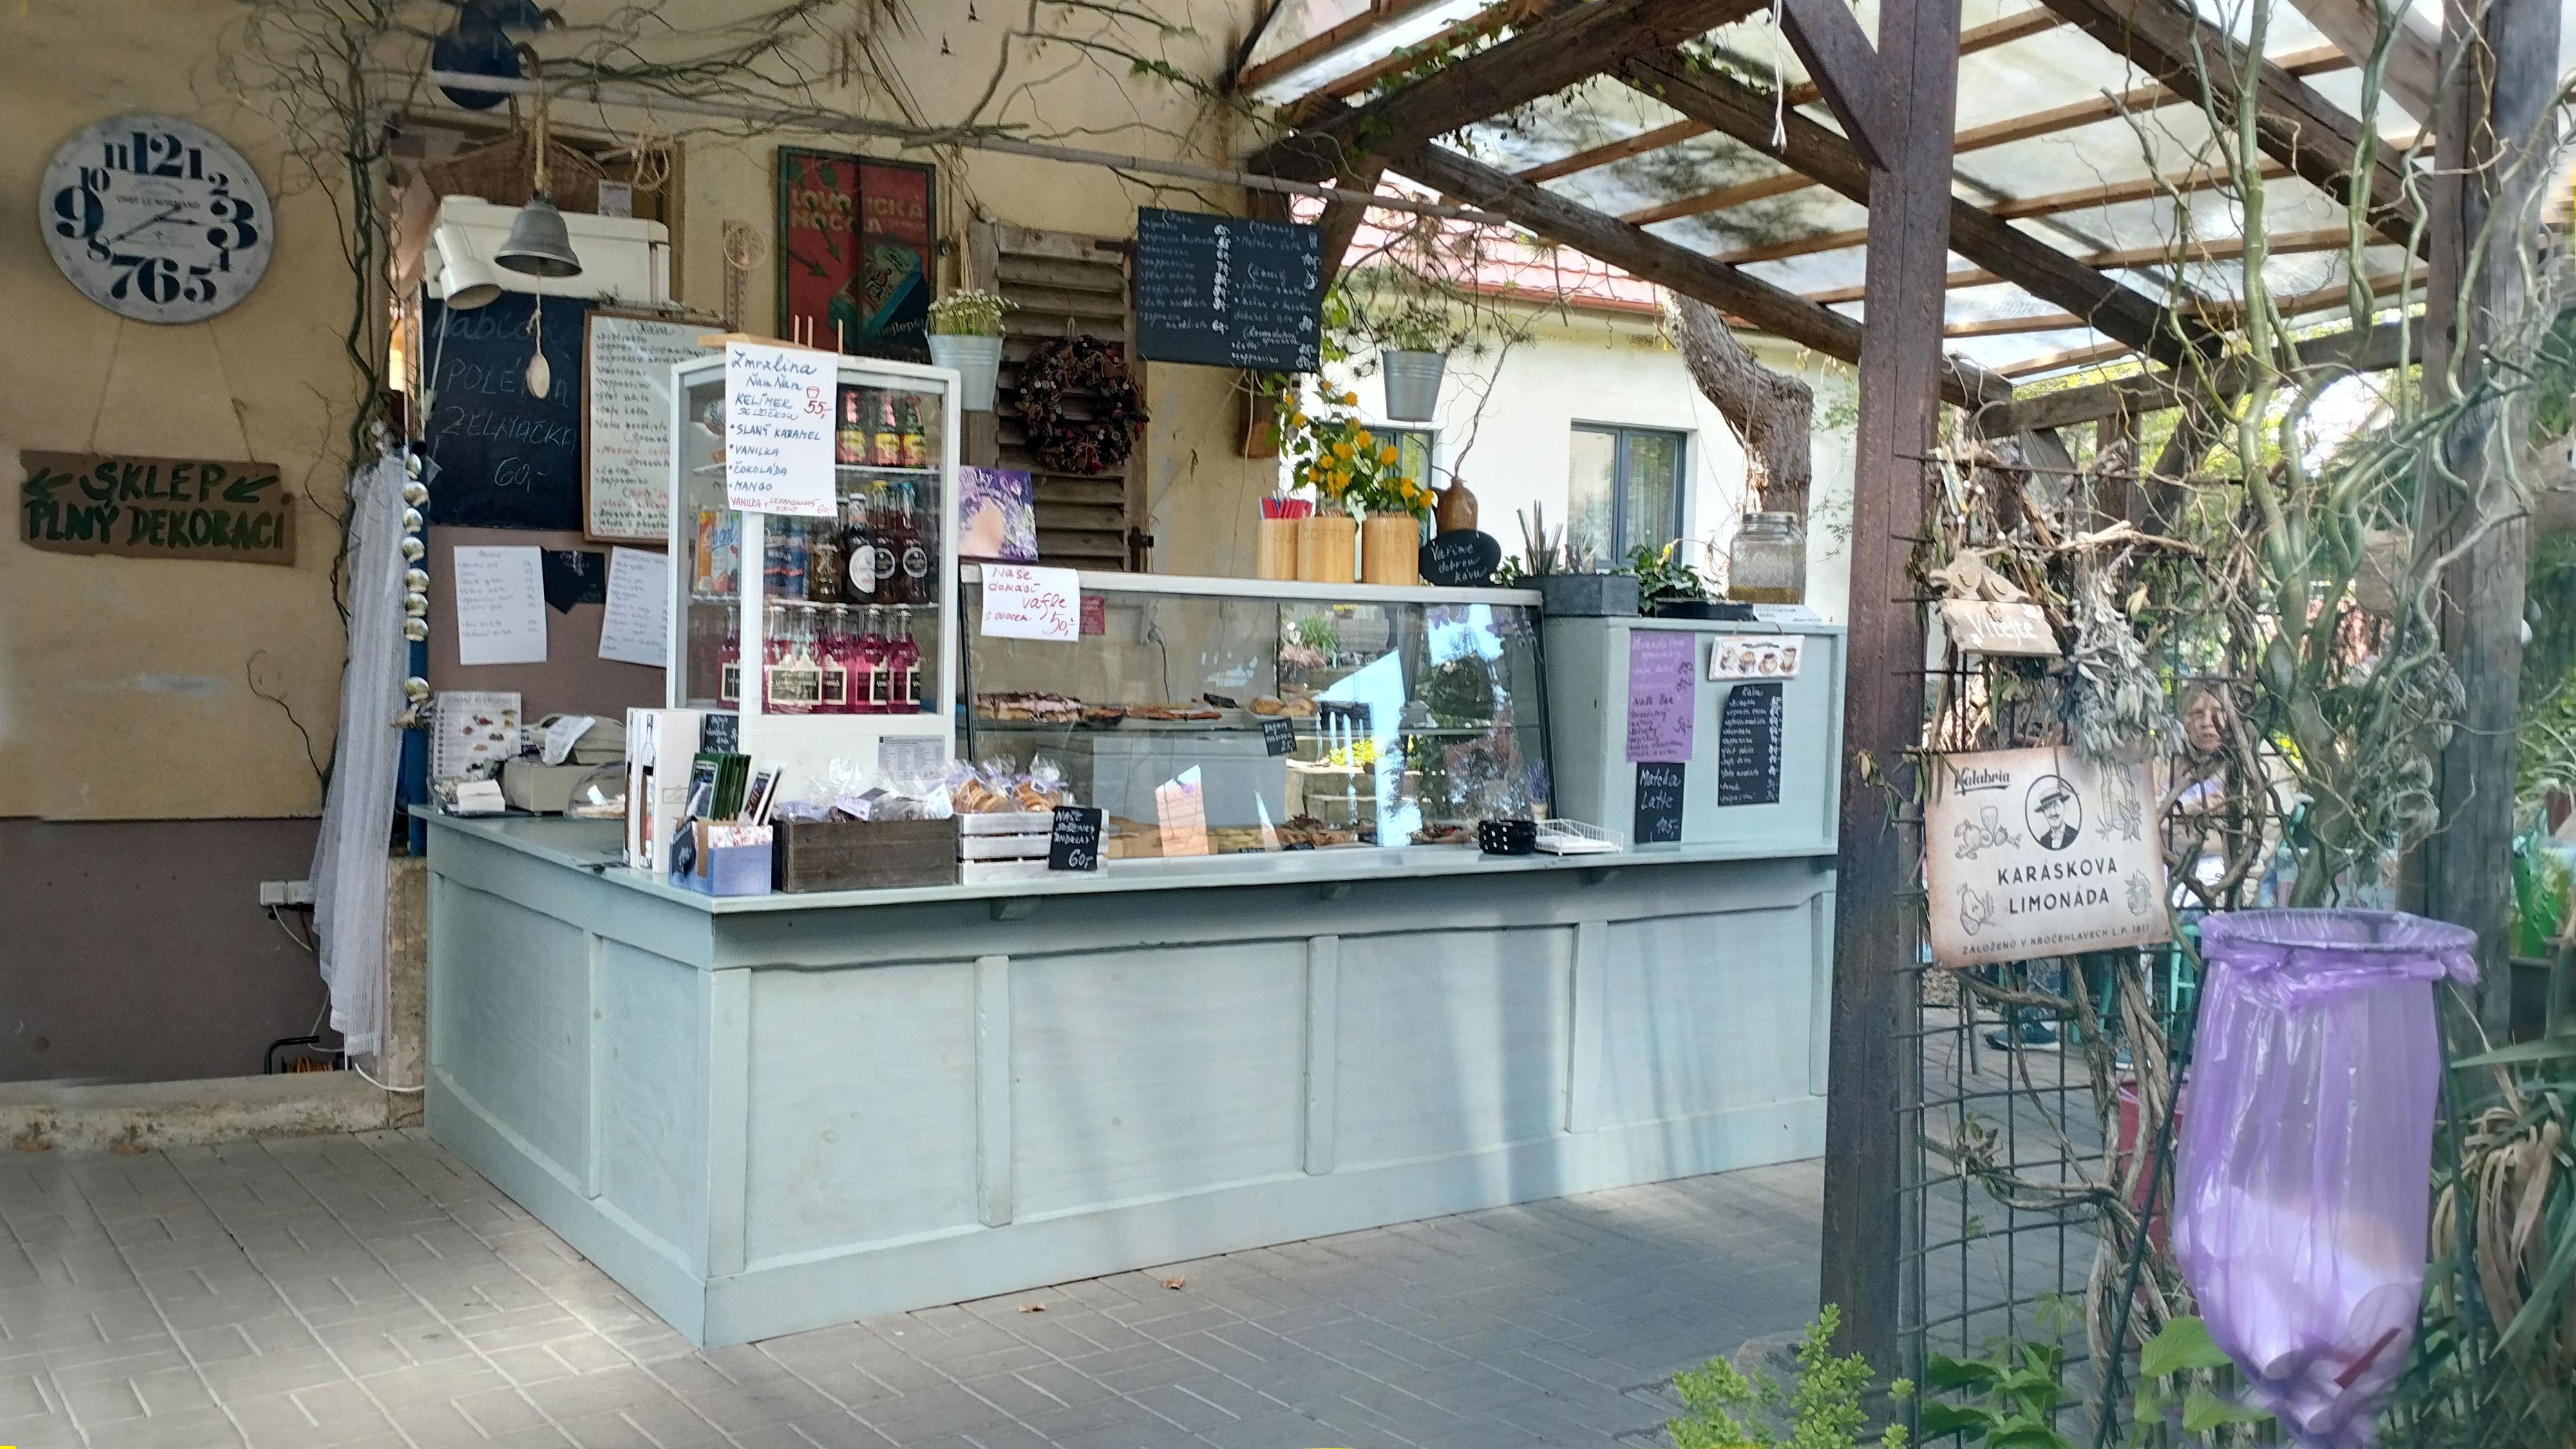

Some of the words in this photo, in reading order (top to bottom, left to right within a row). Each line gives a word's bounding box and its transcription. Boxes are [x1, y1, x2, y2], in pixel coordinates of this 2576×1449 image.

[103, 142, 128, 171] 11
[131, 131, 185, 179] 12
[187, 148, 204, 179] 1
[79, 166, 111, 193] 10
[207, 171, 229, 197] 2
[53, 185, 104, 238] 9
[206, 196, 258, 251] 3
[87, 236, 111, 261] 8
[109, 254, 146, 299] 7
[137, 257, 180, 304] 6
[184, 265, 218, 303] 5
[732, 350, 817, 375] Zmrzlina
[442, 358, 568, 408] POLÉA
[774, 428, 820, 440] KARAMEL
[735, 445, 779, 456] VANILKA
[79, 462, 225, 502] SKLEP
[734, 460, 788, 476] ČOKOLÁDA
[731, 497, 762, 508] VANILKA
[992, 567, 1032, 580] Naše
[1998, 857, 2117, 886] KARÁSKOVA
[2009, 884, 2110, 914] LIMONÁDA
[1962, 941, 2016, 956] ZALOŽENO
